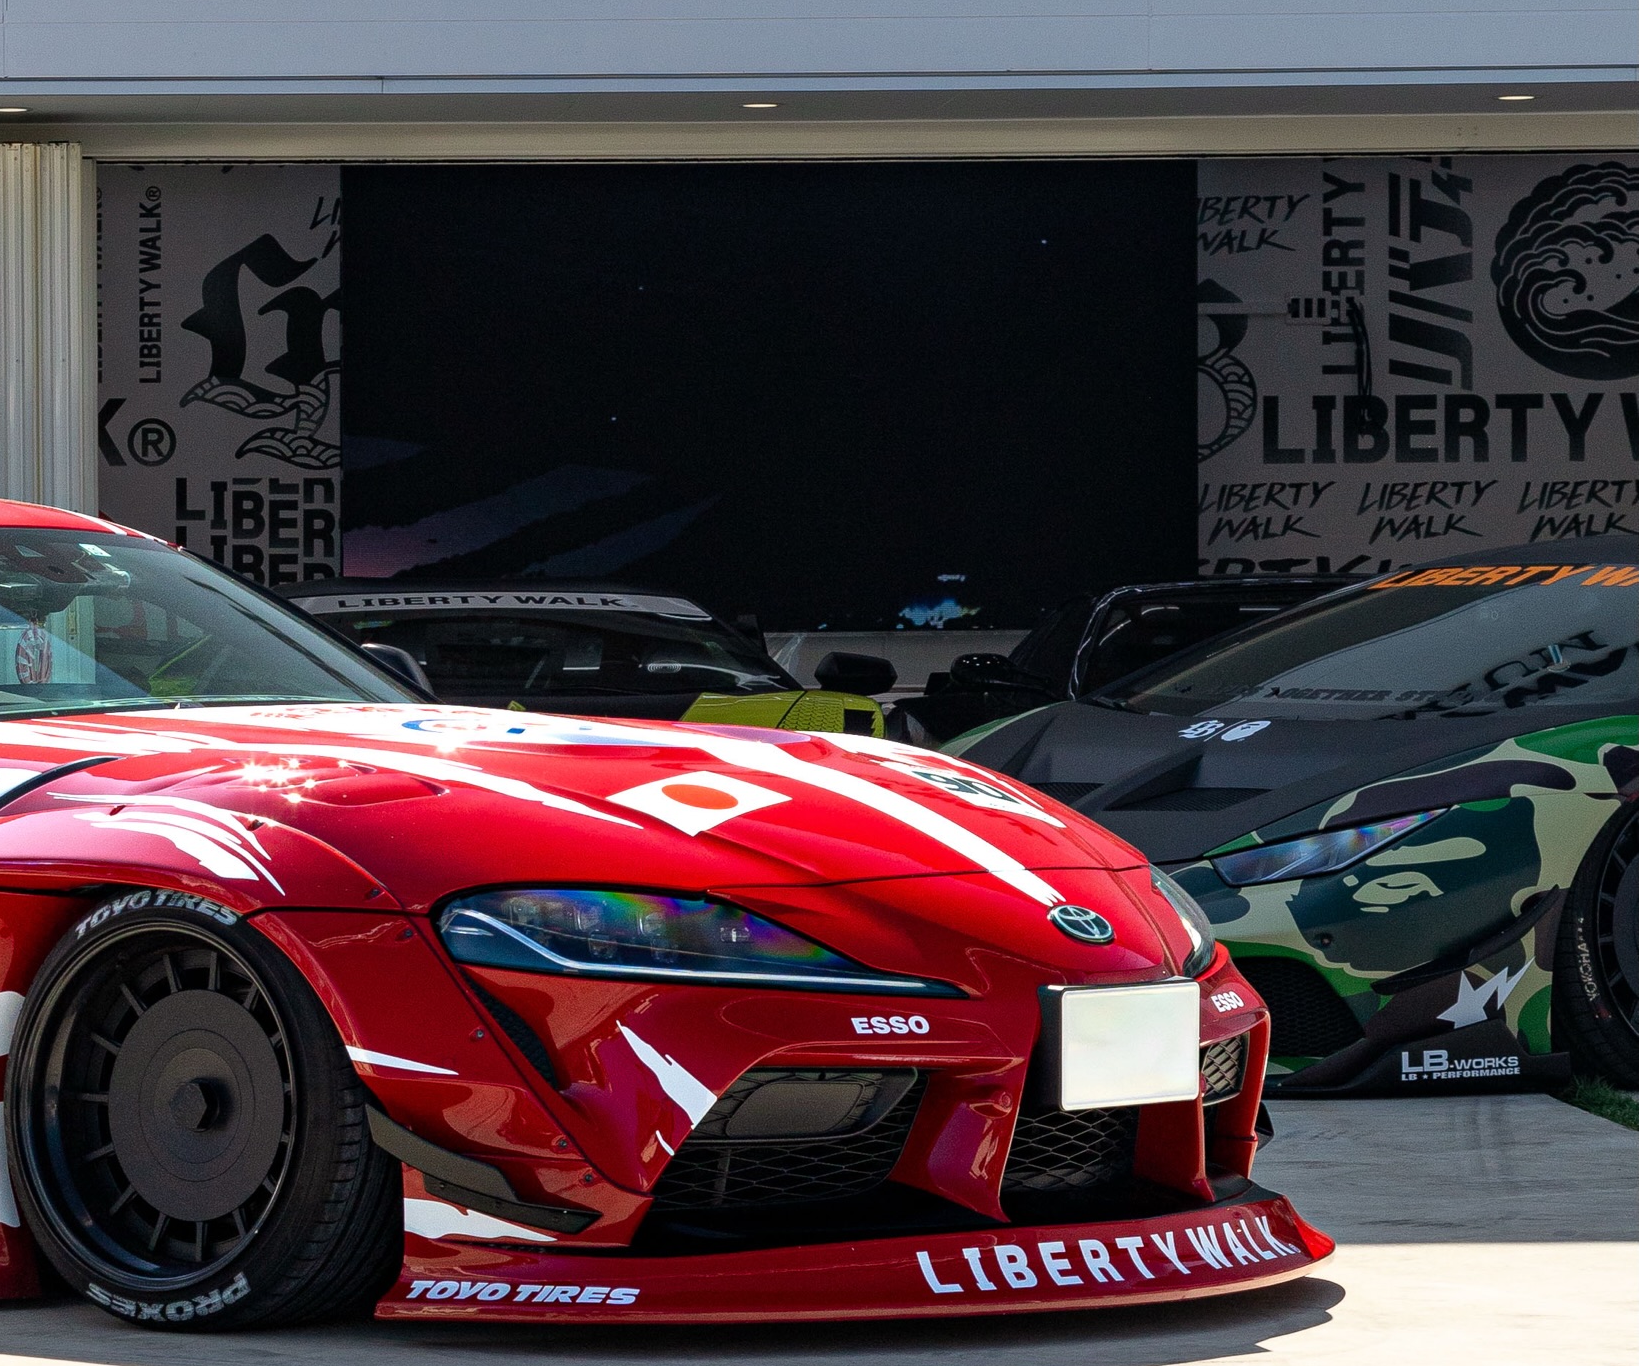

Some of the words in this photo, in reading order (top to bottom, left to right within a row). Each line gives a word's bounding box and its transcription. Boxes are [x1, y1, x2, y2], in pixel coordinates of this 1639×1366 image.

[1196, 193, 1311, 226] BERTY
[138, 278, 162, 384] LIBERTY
[1264, 392, 1604, 465] LIBERTY
[1199, 480, 1336, 514] LIBERTY
[1357, 480, 1498, 516] LIBERTY
[1207, 513, 1322, 547] WALK
[1368, 513, 1484, 545] WALK
[1528, 512, 1639, 543] WALK
[1367, 565, 1595, 590] LIBERTY
[338, 595, 505, 609] LIBERTY
[75, 890, 154, 940] TOYO
[155, 890, 244, 928] TIRES
[1575, 917, 1600, 1002] YOKOHA
[1210, 990, 1245, 1013] ESSO
[851, 1016, 930, 1035] ESSO
[1432, 1067, 1521, 1080] PERFORMANCE
[916, 1231, 1192, 1295] LIBERTY
[86, 1271, 252, 1323] PROXES
[405, 1280, 511, 1301] TOYO
[512, 1284, 641, 1305] TIRES
